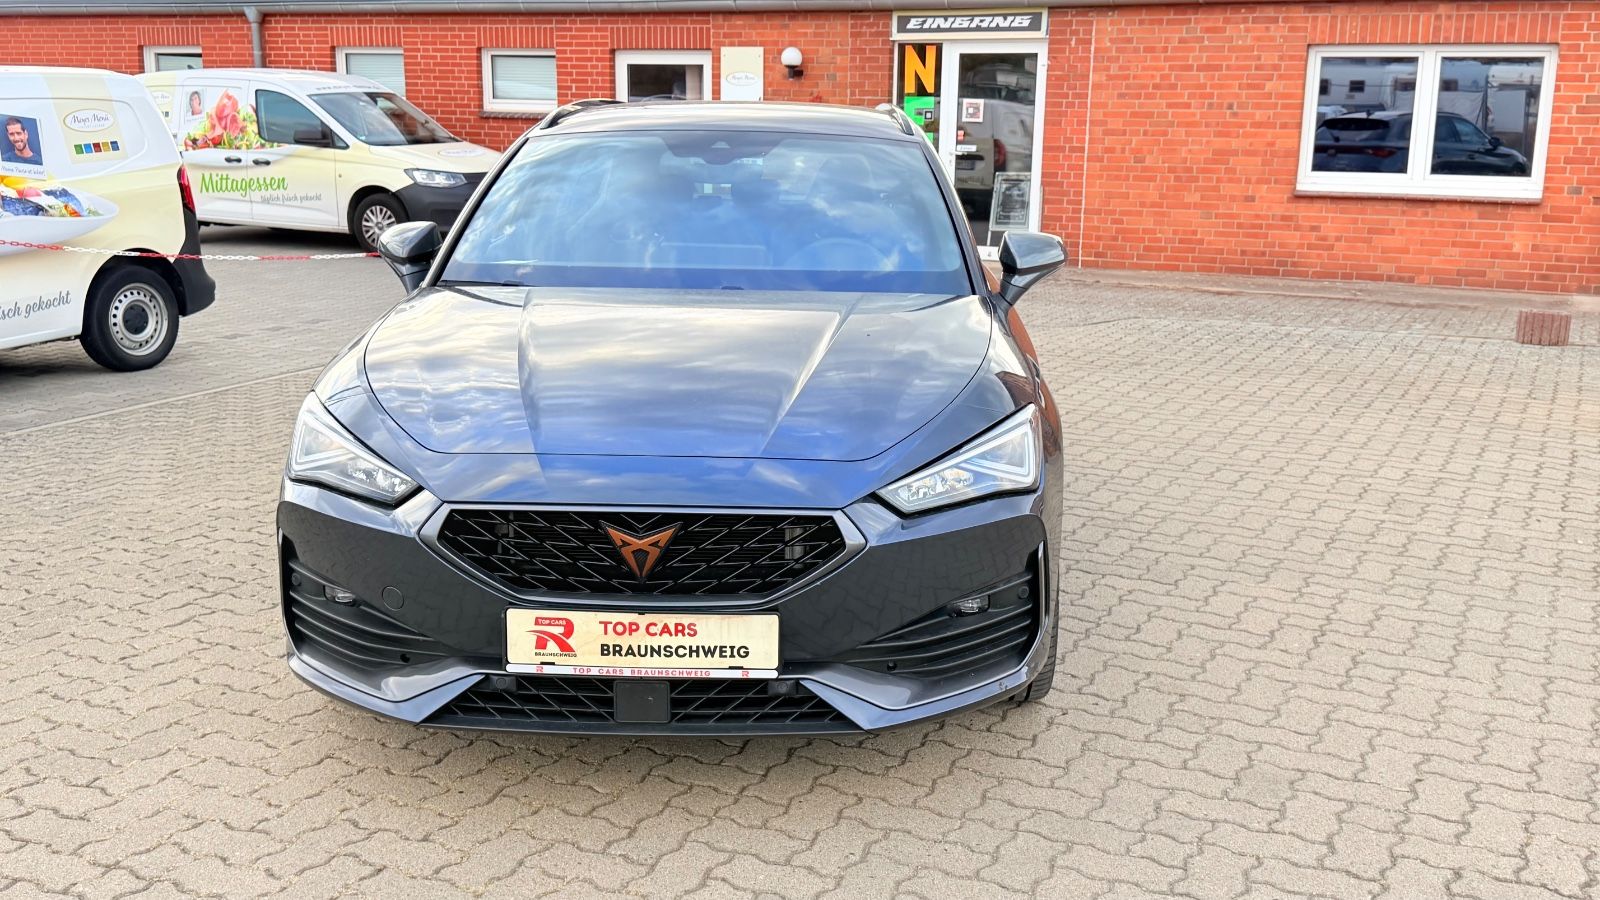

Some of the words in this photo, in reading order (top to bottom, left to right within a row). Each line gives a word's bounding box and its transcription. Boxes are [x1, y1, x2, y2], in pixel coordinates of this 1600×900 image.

[906, 15, 1033, 29] EINGANG
[200, 173, 288, 197] Mittagessen
[25, 290, 71, 319] gekocht
[599, 621, 640, 636] TOP
[645, 622, 698, 637] CARS
[600, 643, 750, 659] BRAUNSCHWEIG
[630, 669, 711, 677] BRAUNSCHWEIG
